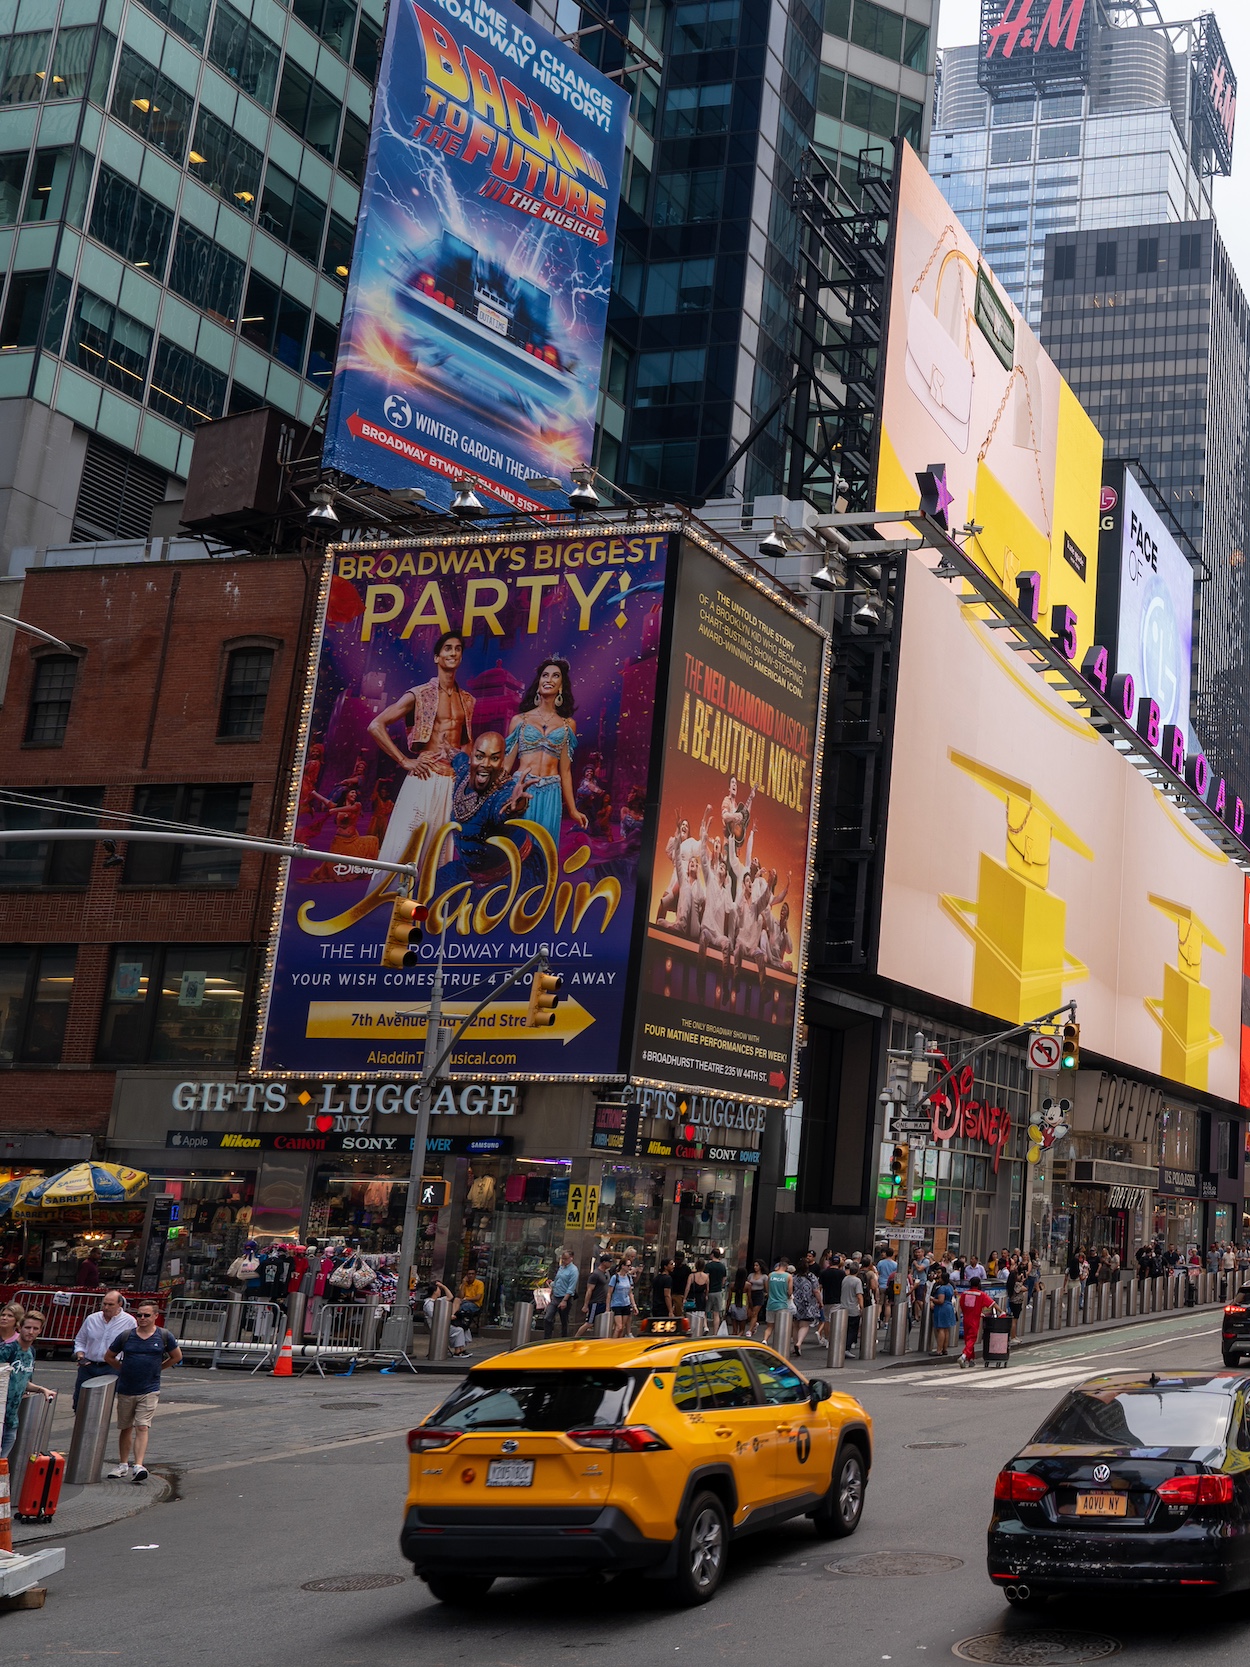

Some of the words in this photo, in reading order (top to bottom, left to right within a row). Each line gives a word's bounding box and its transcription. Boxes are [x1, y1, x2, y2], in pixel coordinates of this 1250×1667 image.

[986, 0, 1085, 58] H&M
[465, 0, 508, 35] TIME
[511, 23, 536, 56] TO
[540, 49, 613, 116] CHANGE
[411, 1, 590, 182] BACK
[424, 86, 469, 135] TO
[533, 61, 610, 133] HISTORY!
[1210, 55, 1236, 147] H&M
[413, 115, 463, 155] THE
[462, 118, 606, 227] FUTURE
[510, 191, 542, 215] THE
[543, 205, 600, 242] MUSICAL
[415, 411, 459, 448] WINTER
[460, 436, 503, 470] GARDEN
[361, 423, 428, 462] BROADWAY
[429, 455, 463, 482] BTWN
[492, 486, 515, 504] AND
[516, 497, 539, 513] 51ST
[337, 547, 526, 580] BROADWAY’S
[533, 536, 664, 570] BIGGEST
[1131, 510, 1157, 574] FACE
[1129, 550, 1143, 586] OF
[360, 570, 633, 642] PARTY!
[716, 591, 731, 608] THE
[731, 600, 757, 626] UNTOLD
[758, 620, 774, 638] TRUE
[775, 631, 795, 652] STORY
[699, 593, 709, 607] OF
[716, 603, 750, 637] BROOKLYN
[751, 628, 762, 644] KID
[763, 636, 777, 654] WHO
[778, 646, 801, 671] BECAME
[700, 609, 753, 651] CHART-BUSTING,
[754, 645, 804, 687] SHOW-STOPPING,
[1018, 571, 1135, 719] 1540
[699, 623, 753, 665] AWARD-WINNING
[754, 662, 786, 689] AMERICAN
[786, 682, 803, 699] ICON.
[685, 653, 703, 695] THE
[703, 667, 726, 710] NEIL
[727, 680, 774, 736] DIAMOND
[775, 709, 809, 759] MUSICAL
[677, 692, 691, 753] A
[692, 700, 765, 793] BEAUTIFUL
[767, 742, 807, 813] NOISE
[297, 819, 622, 936] Aladdin
[320, 943, 354, 959] THE
[360, 943, 386, 959] HIT
[292, 973, 331, 986] YOUR
[338, 973, 377, 986] WISH
[383, 973, 434, 986] COMES
[442, 973, 481, 986] TRUE
[488, 973, 496, 986] 4
[571, 972, 616, 985] AWAY
[351, 1013, 373, 1026] 7th
[376, 1013, 427, 1027] Avenue
[682, 1019, 692, 1028] THE
[693, 1020, 706, 1031] ONLY
[706, 1024, 733, 1037] BROADWAY
[733, 1031, 747, 1040] SHOW
[644, 1024, 666, 1038] FOUR
[667, 1028, 699, 1045] MATINEE
[700, 1035, 754, 1056] PERFORMANCES
[755, 1048, 767, 1058] PER
[768, 1051, 787, 1063] WEEK!
[647, 1051, 695, 1069] BROADHURST
[696, 1058, 724, 1075] THEATRE
[724, 1066, 737, 1076] 235
[743, 1069, 758, 1081] 44TH
[171, 1081, 287, 1113] GIFTS
[689, 1095, 767, 1132] LUGGAGE
[1092, 1071, 1163, 1144] FOREVER
[183, 1135, 208, 1149] Apple
[220, 1134, 261, 1148] Nikon
[274, 1135, 328, 1151] Canon
[342, 1137, 396, 1150] SONY
[410, 1137, 452, 1151] BWER
[471, 1141, 499, 1150] SAMSUNG
[332, 1115, 369, 1133] NY
[693, 1126, 713, 1144] NY
[648, 1141, 672, 1155] Nikon
[709, 1147, 737, 1161] SONY
[740, 1151, 761, 1163] BOWER
[15, 1210, 57, 1219] SABRETT
[44, 1194, 91, 1205] SABRETT
[568, 1187, 583, 1223] ATM
[586, 1188, 596, 1223] ATM
[1108, 1186, 1137, 1210] FOREVER
[651, 1320, 678, 1334] 3E45
[1108, 1496, 1120, 1510] NY
